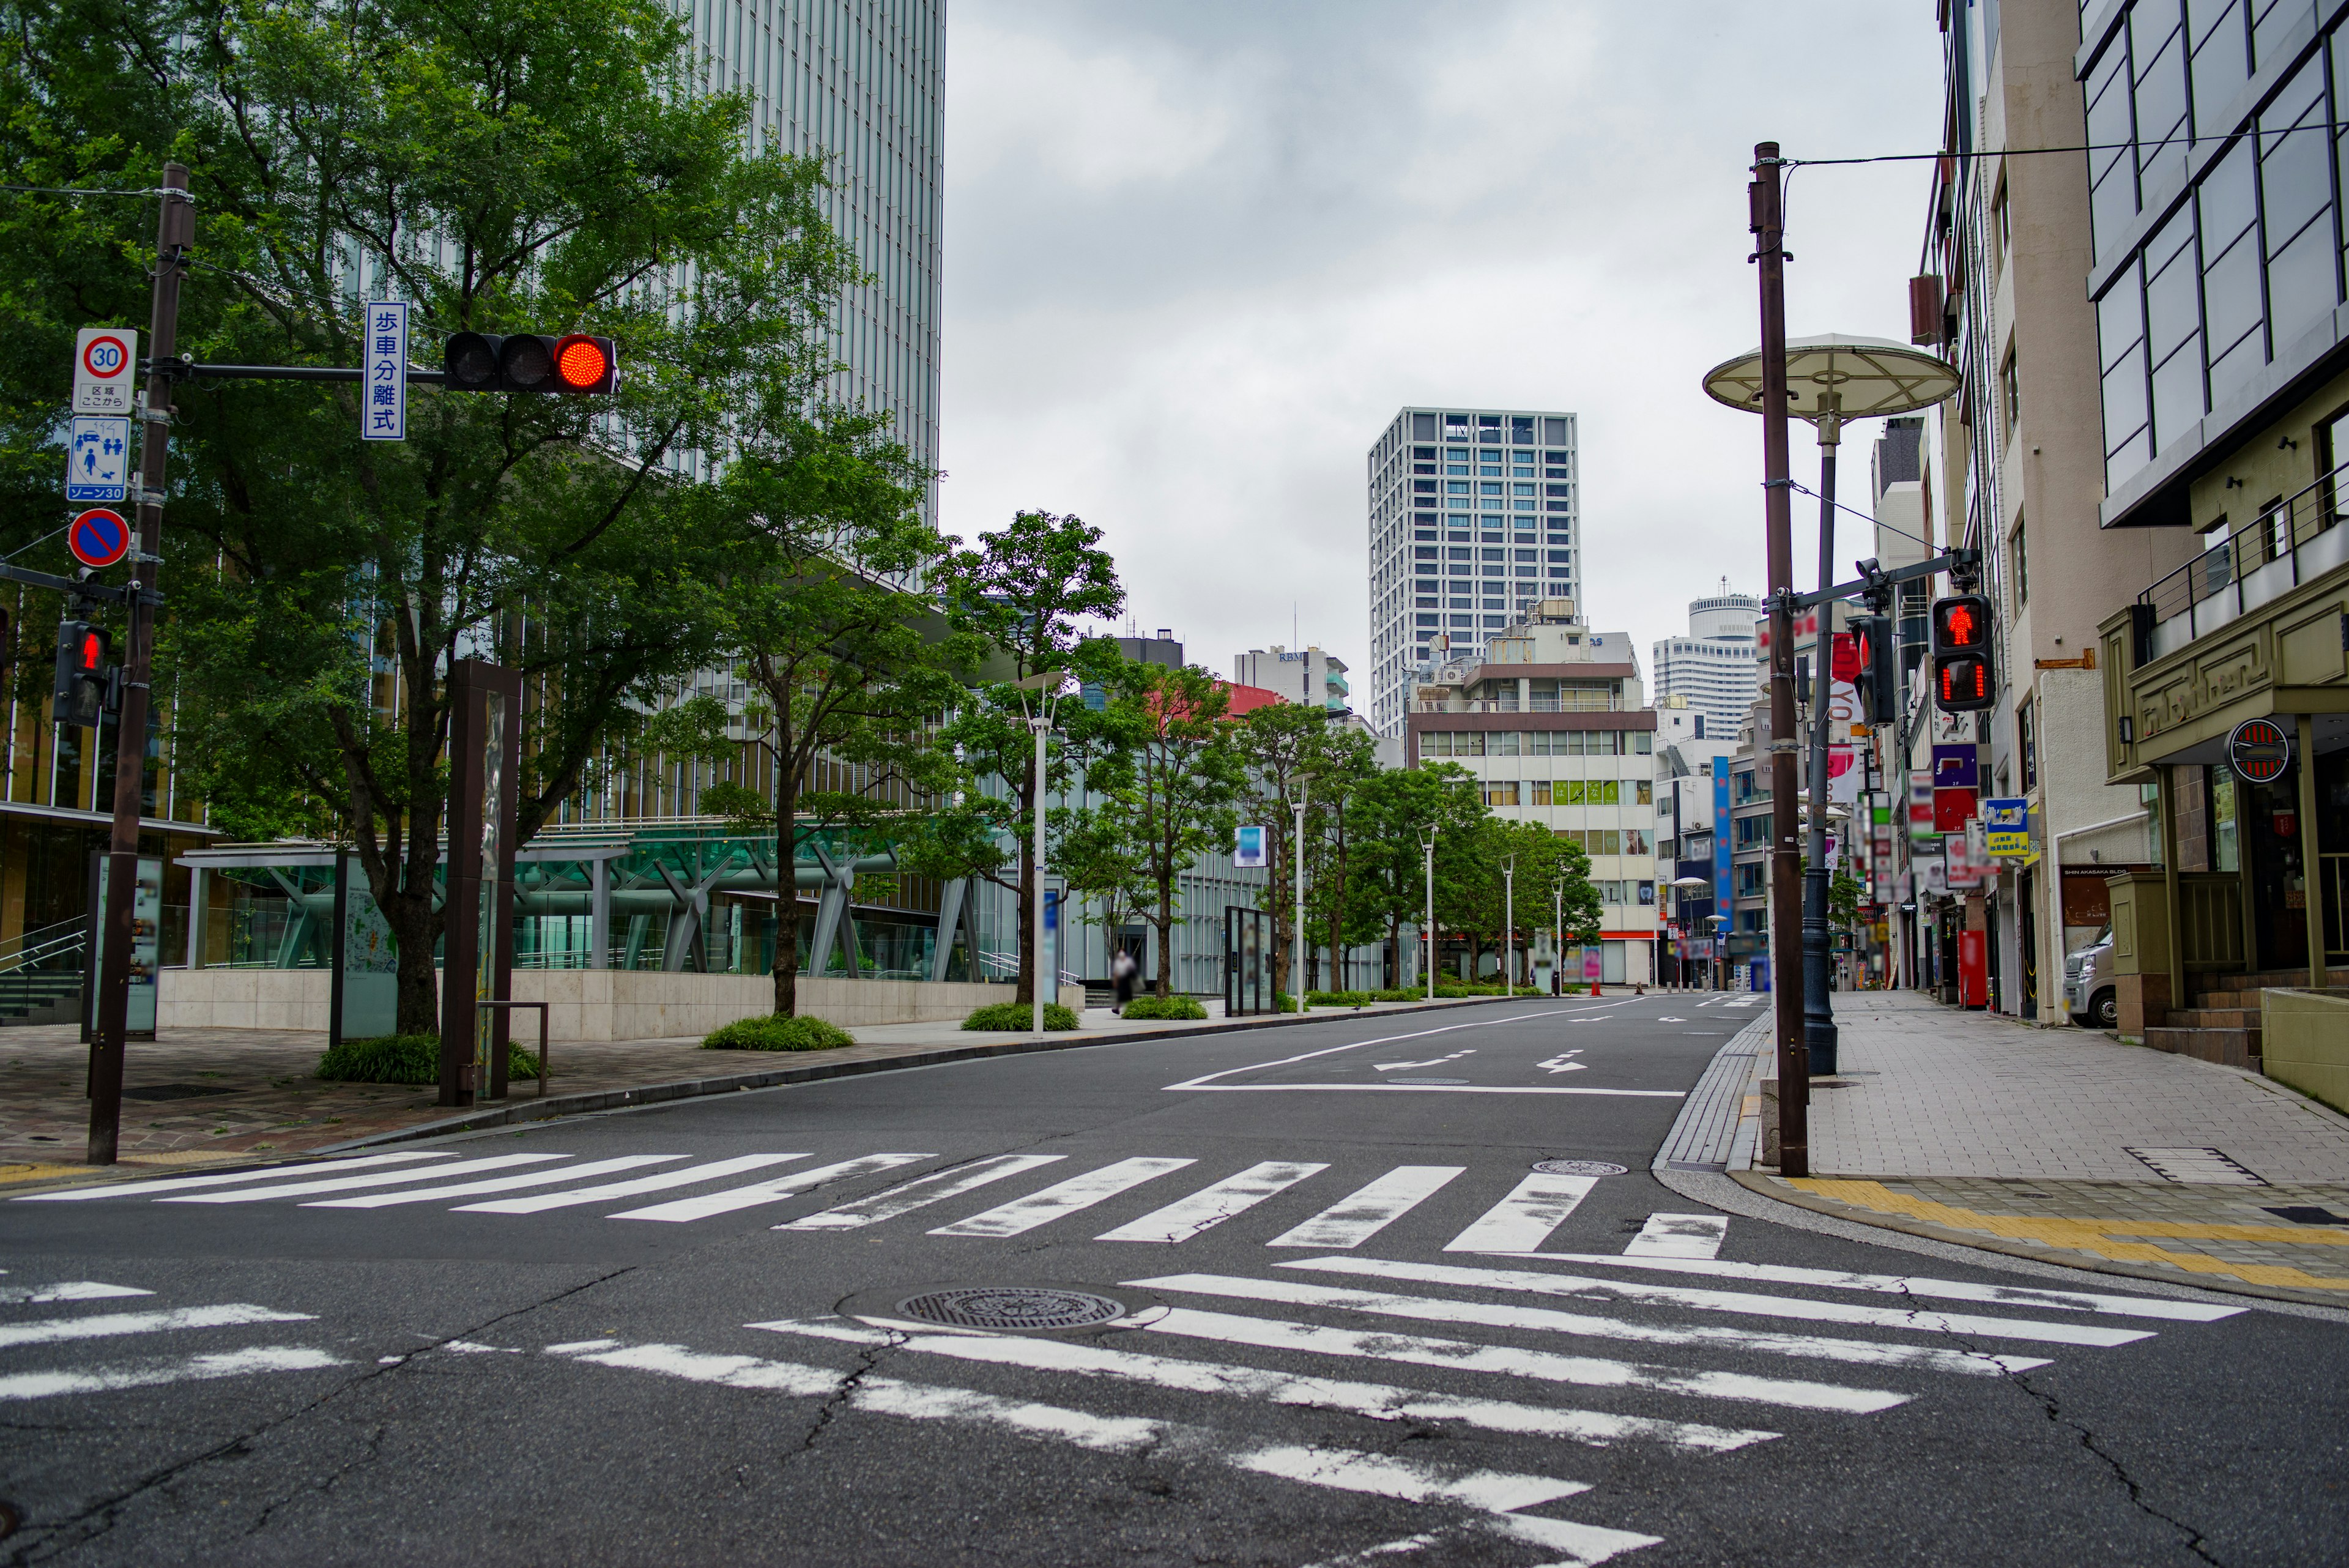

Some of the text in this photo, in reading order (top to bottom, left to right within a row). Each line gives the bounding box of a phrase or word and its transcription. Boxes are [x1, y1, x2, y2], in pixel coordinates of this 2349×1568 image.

[94, 347, 118, 366] 30
[373, 312, 398, 430] 歩車分離式
[92, 387, 114, 396] 区域
[83, 397, 122, 406] ここから
[71, 488, 121, 499] ゾーン30
[1278, 652, 1303, 662] RBM
[1556, 788, 1614, 797] はんなり
